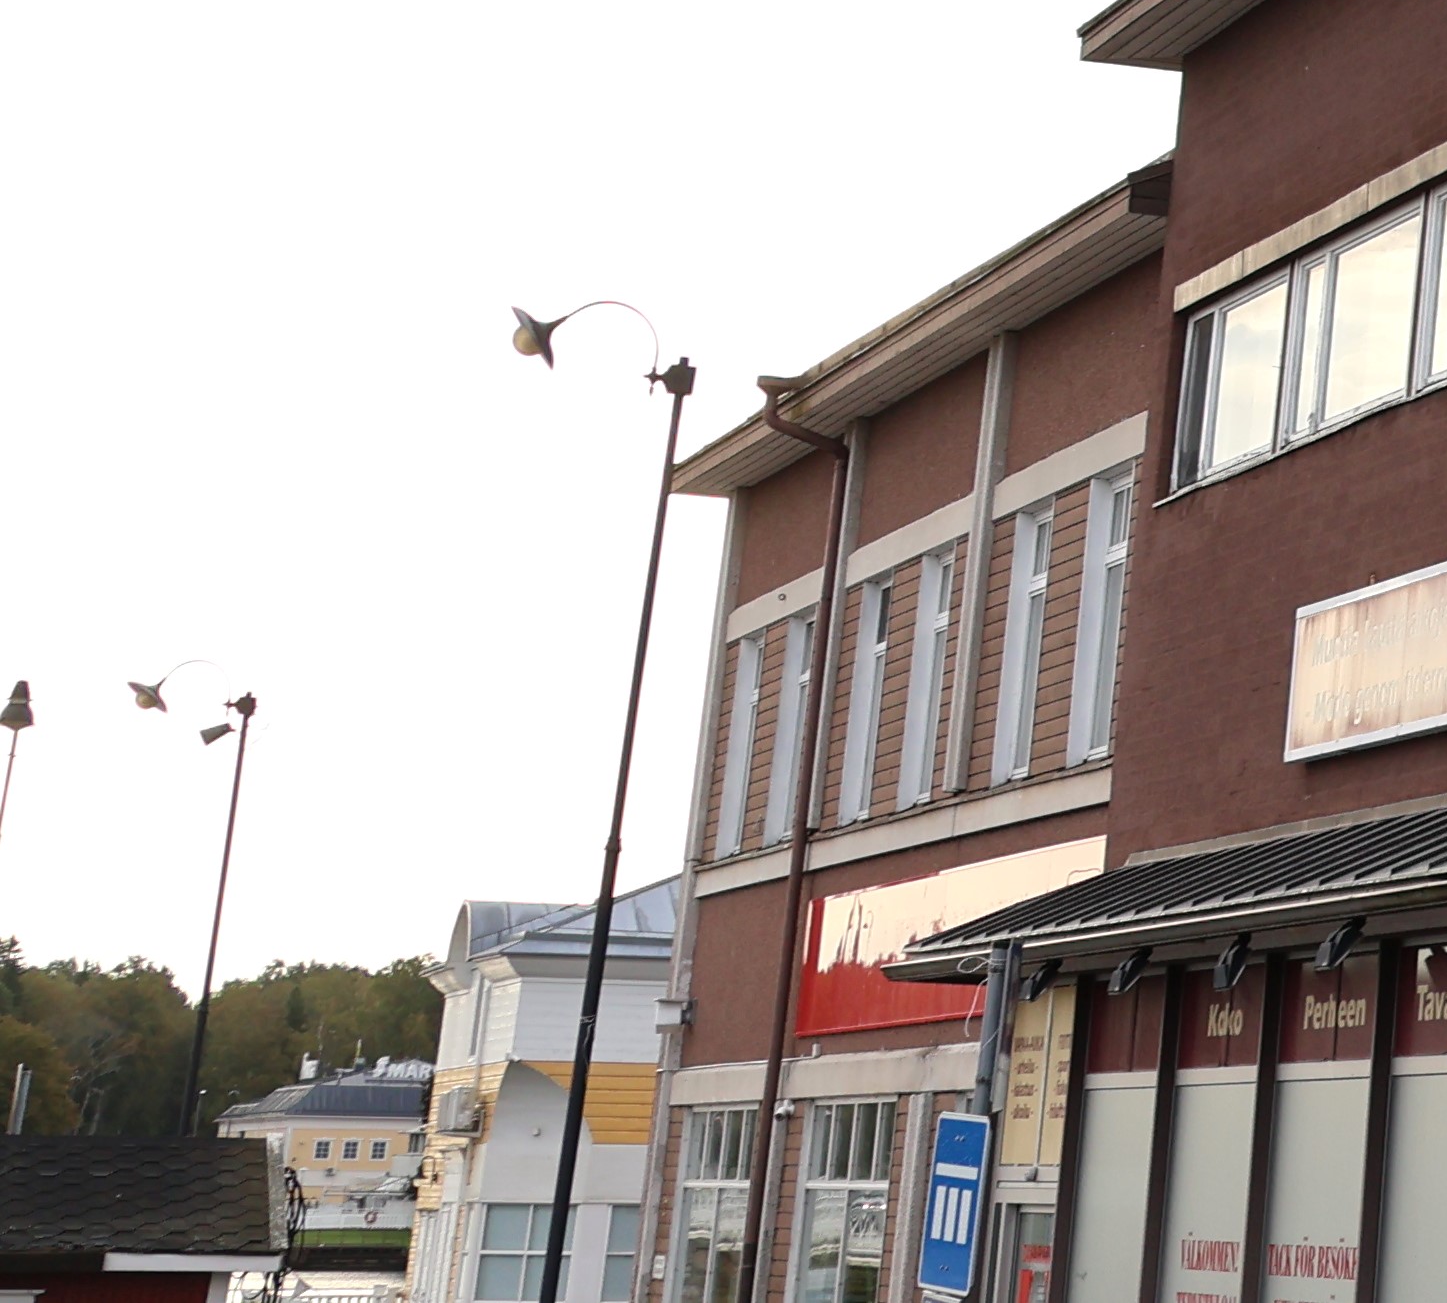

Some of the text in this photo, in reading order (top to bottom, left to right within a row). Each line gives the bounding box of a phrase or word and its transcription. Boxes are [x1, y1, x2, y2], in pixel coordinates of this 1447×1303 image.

[1302, 993, 1367, 1031] Perheen
[1266, 1243, 1293, 1277] TACK
[1294, 1236, 1316, 1278] FÖR
